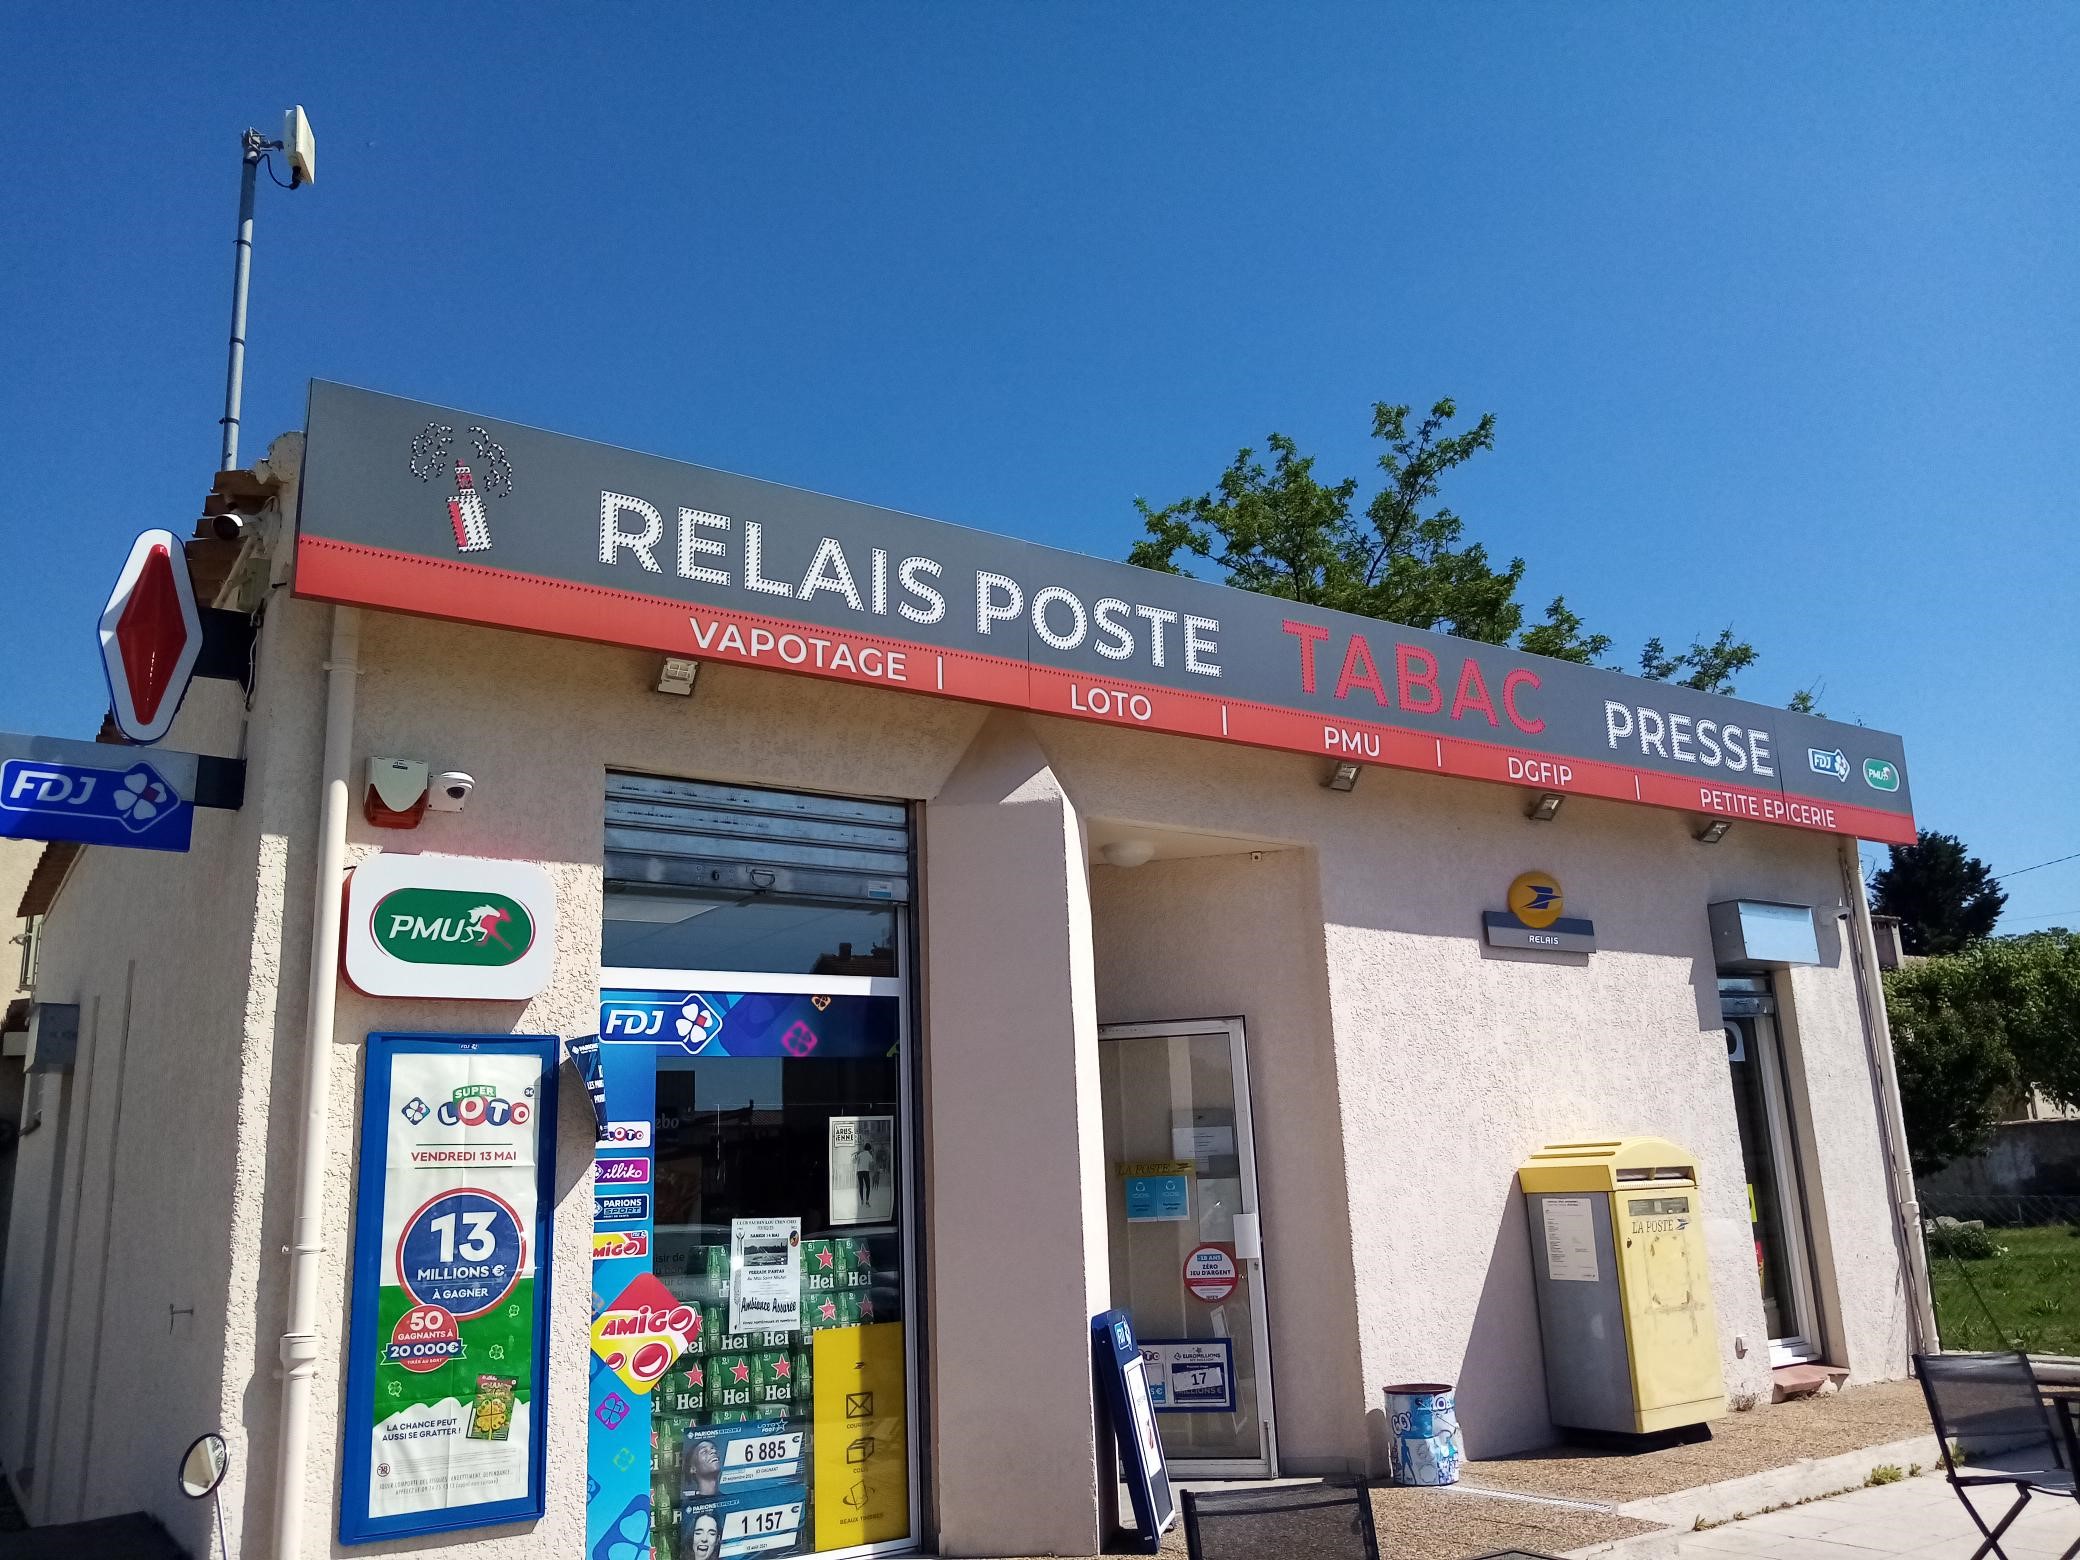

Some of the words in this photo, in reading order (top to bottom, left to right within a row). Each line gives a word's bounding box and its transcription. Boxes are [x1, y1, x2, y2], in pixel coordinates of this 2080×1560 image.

[598, 490, 946, 625] RELAIS
[976, 570, 1223, 678] POSTE
[1282, 618, 1547, 735] TABAC
[1604, 699, 1775, 778] PRESSE
[689, 616, 907, 682] VAPOTAGE
[1071, 683, 1152, 721] LOTO
[1324, 726, 1380, 758] PMU
[1508, 757, 1573, 786] DGFIP
[1700, 787, 1760, 817] PETITE
[1763, 798, 1837, 829] EPICERIE
[1814, 754, 1831, 769] FDJ
[1867, 768, 1885, 780] PMU
[10, 769, 97, 804] FDJ
[388, 914, 467, 943] PMU
[1529, 935, 1559, 945] RELAIS
[605, 1009, 664, 1035] FDJ
[453, 1086, 495, 1100] SUPER
[438, 1096, 530, 1126] LOTO
[411, 1151, 476, 1162] VENDREDI
[480, 1151, 491, 1161] 13
[494, 1151, 517, 1161] MAI
[603, 1163, 643, 1179] illiko
[603, 1198, 642, 1208] PARIONS
[604, 1207, 641, 1216] SPORT
[1631, 1221, 1644, 1234] LA
[1646, 1219, 1673, 1233] POSTE
[430, 1211, 497, 1263] 13
[417, 1266, 489, 1281] MILLIONS
[432, 1289, 441, 1300] À
[445, 1288, 488, 1299] GAGNER
[409, 1310, 444, 1331] 50
[398, 1330, 446, 1341] GAGNANTS
[446, 1328, 454, 1338] À
[390, 1346, 411, 1358] 20
[1191, 1372, 1207, 1386] 17
[386, 1424, 399, 1432] LA
[399, 1419, 435, 1431] CHANCE
[437, 1417, 458, 1427] PEUT
[382, 1432, 407, 1442] AUSSI
[408, 1431, 418, 1439] SE
[419, 1427, 456, 1439] GRATTER
[744, 1444, 754, 1463] 6
[758, 1440, 786, 1461] 885
[741, 1515, 748, 1534] 1
[756, 1510, 783, 1532] 157
